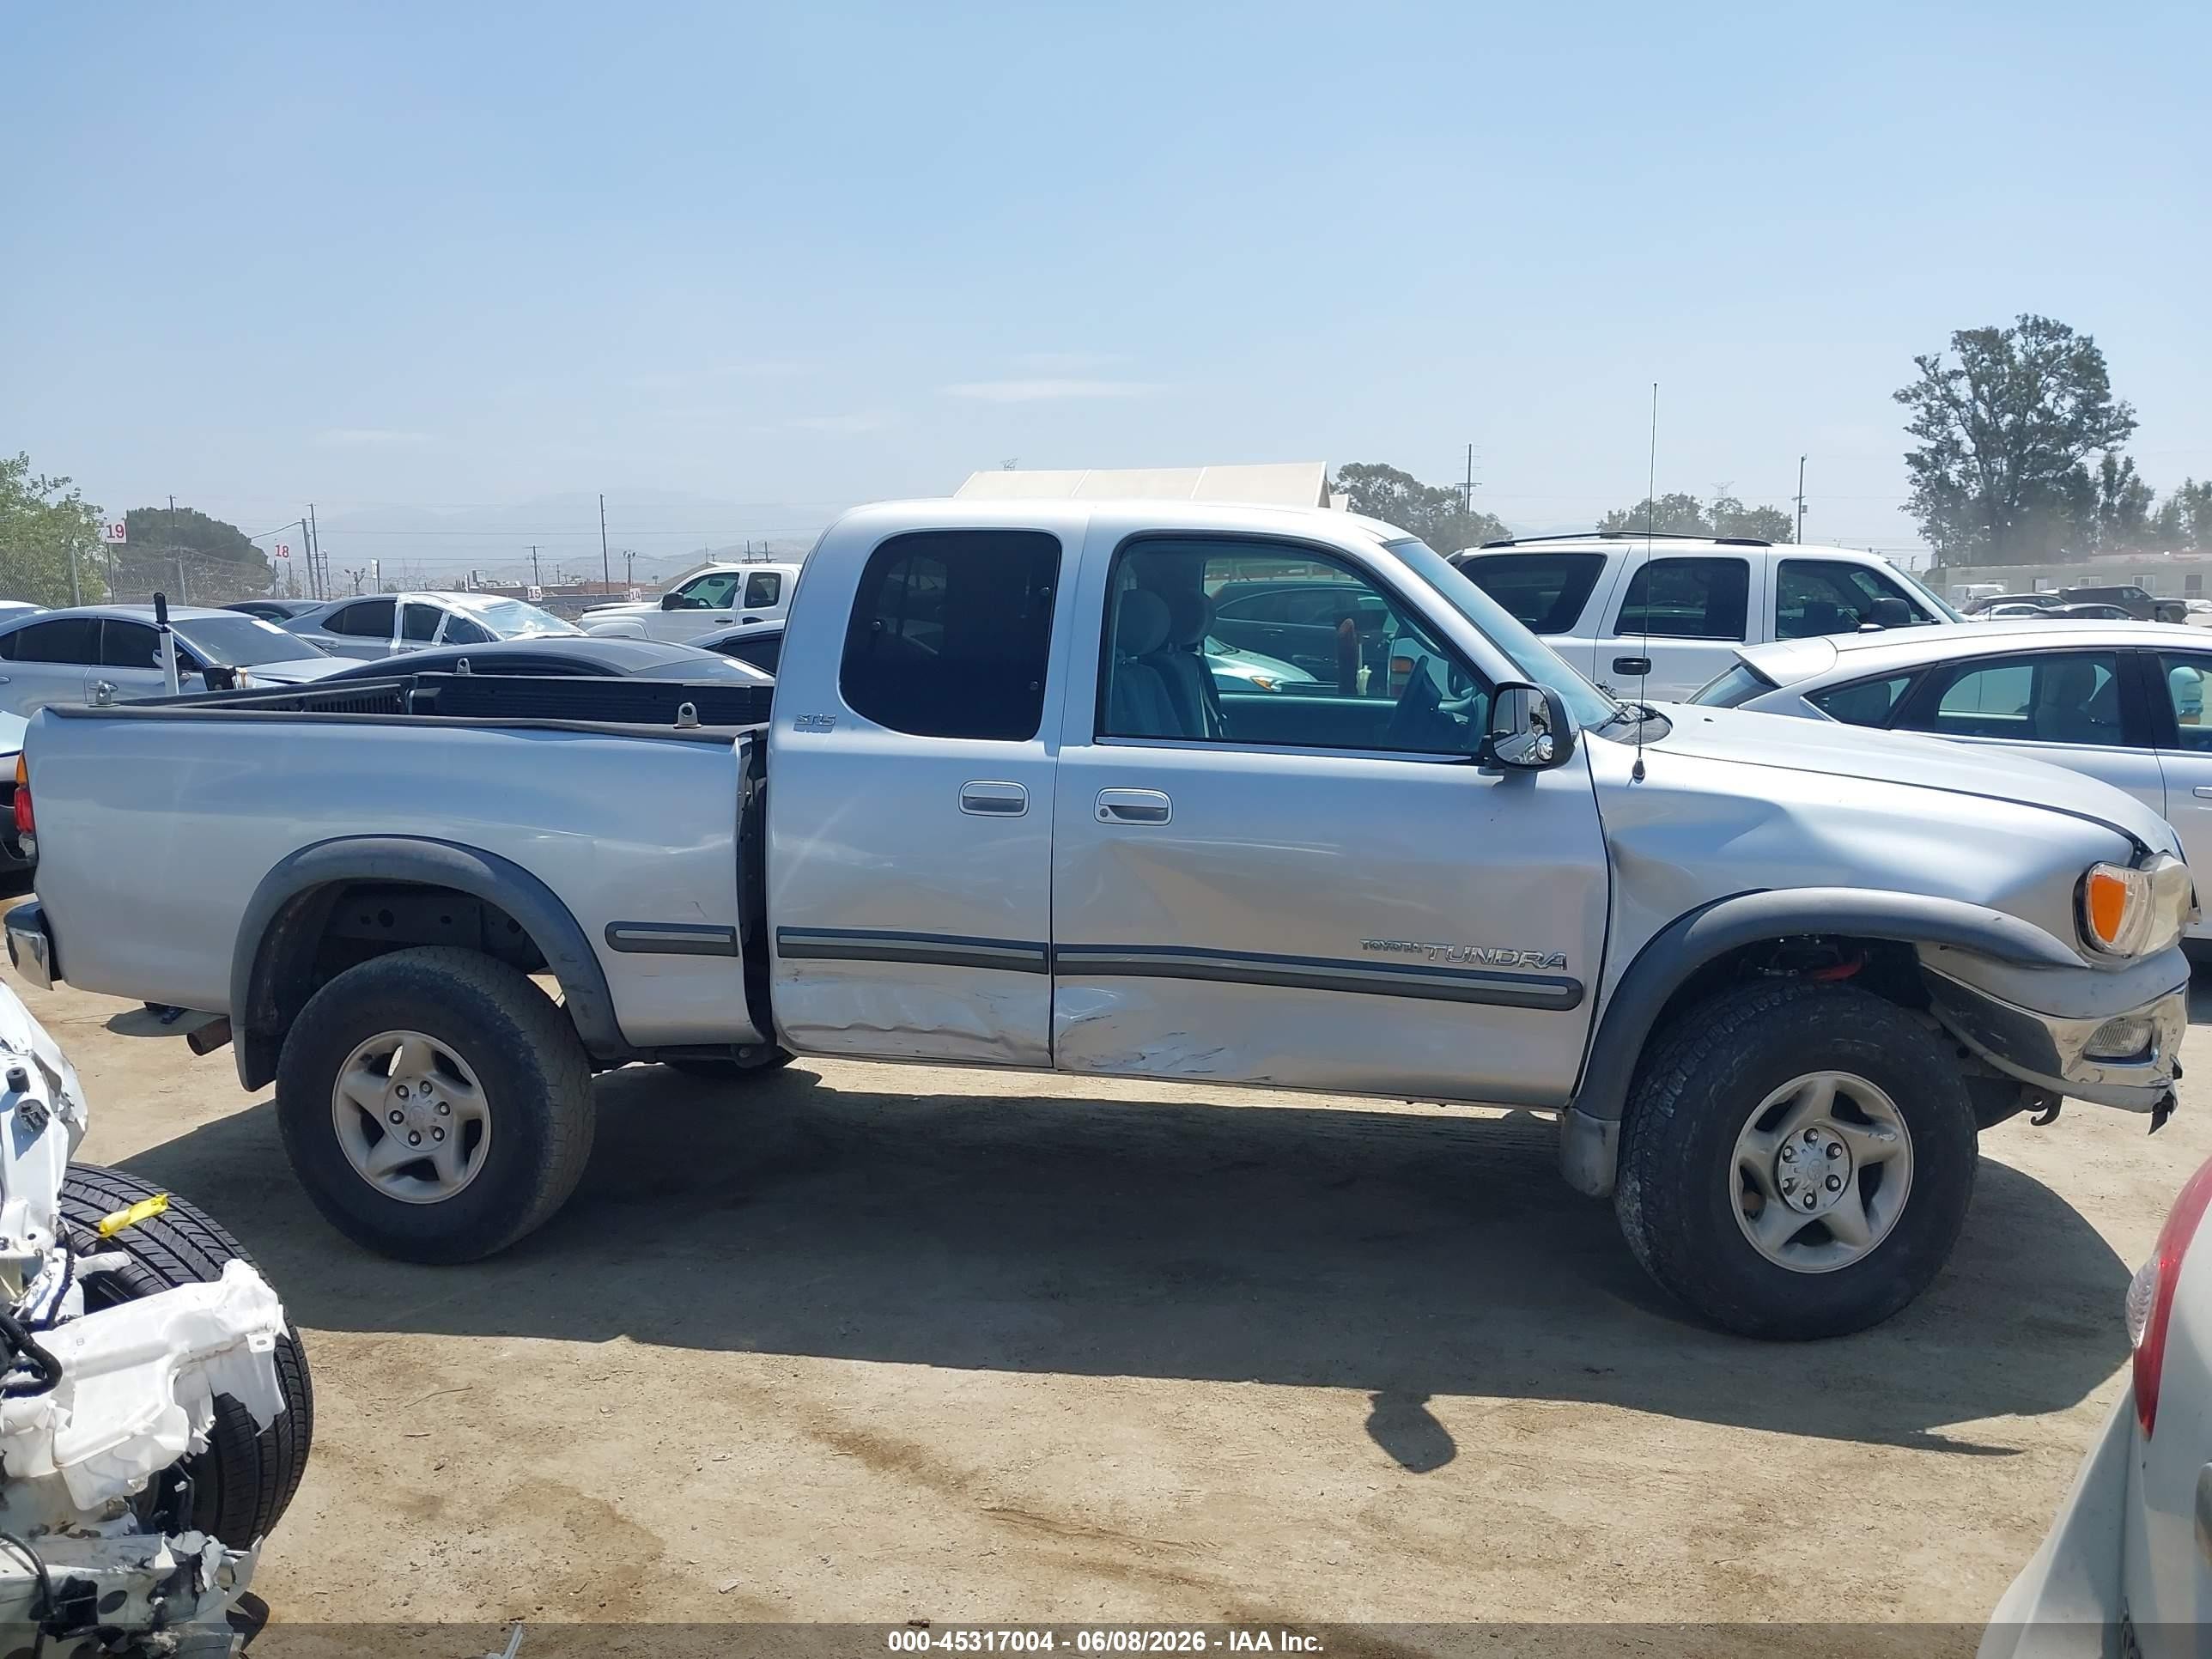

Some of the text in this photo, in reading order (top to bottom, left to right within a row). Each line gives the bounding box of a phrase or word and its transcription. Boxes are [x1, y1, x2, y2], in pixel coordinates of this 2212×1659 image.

[106, 524, 125, 539] 19
[275, 544, 289, 558] 18
[528, 589, 541, 599] 15
[630, 592, 641, 601] 14
[1359, 939, 1568, 971] TOYOTA TUNDRA
